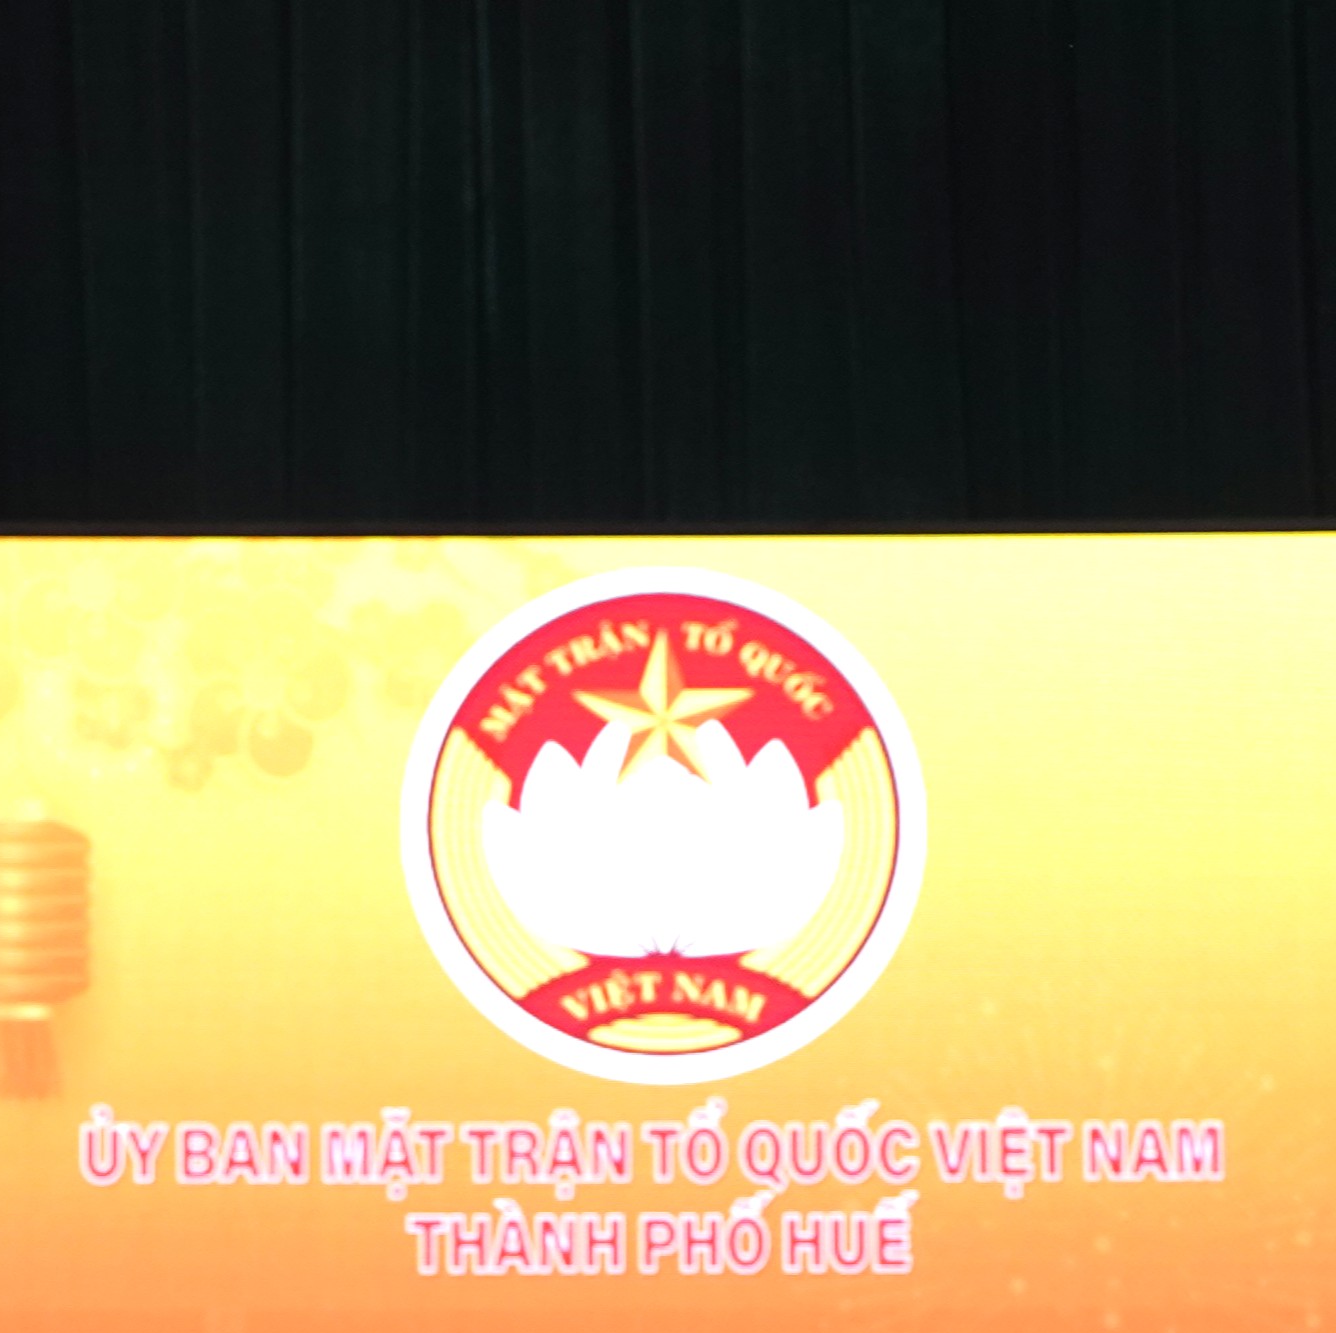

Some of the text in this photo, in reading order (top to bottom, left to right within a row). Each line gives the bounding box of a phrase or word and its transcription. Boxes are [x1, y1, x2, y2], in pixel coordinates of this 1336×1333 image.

[738, 640, 835, 722] QUỐC
[560, 969, 768, 1024] VIỆT NAM
[79, 1096, 1226, 1202] ỦY BAN MẶT TRẬN TỔ QUỐC VIỆT NAM
[404, 1189, 921, 1276] THÀNH PHỐ HUẾ
